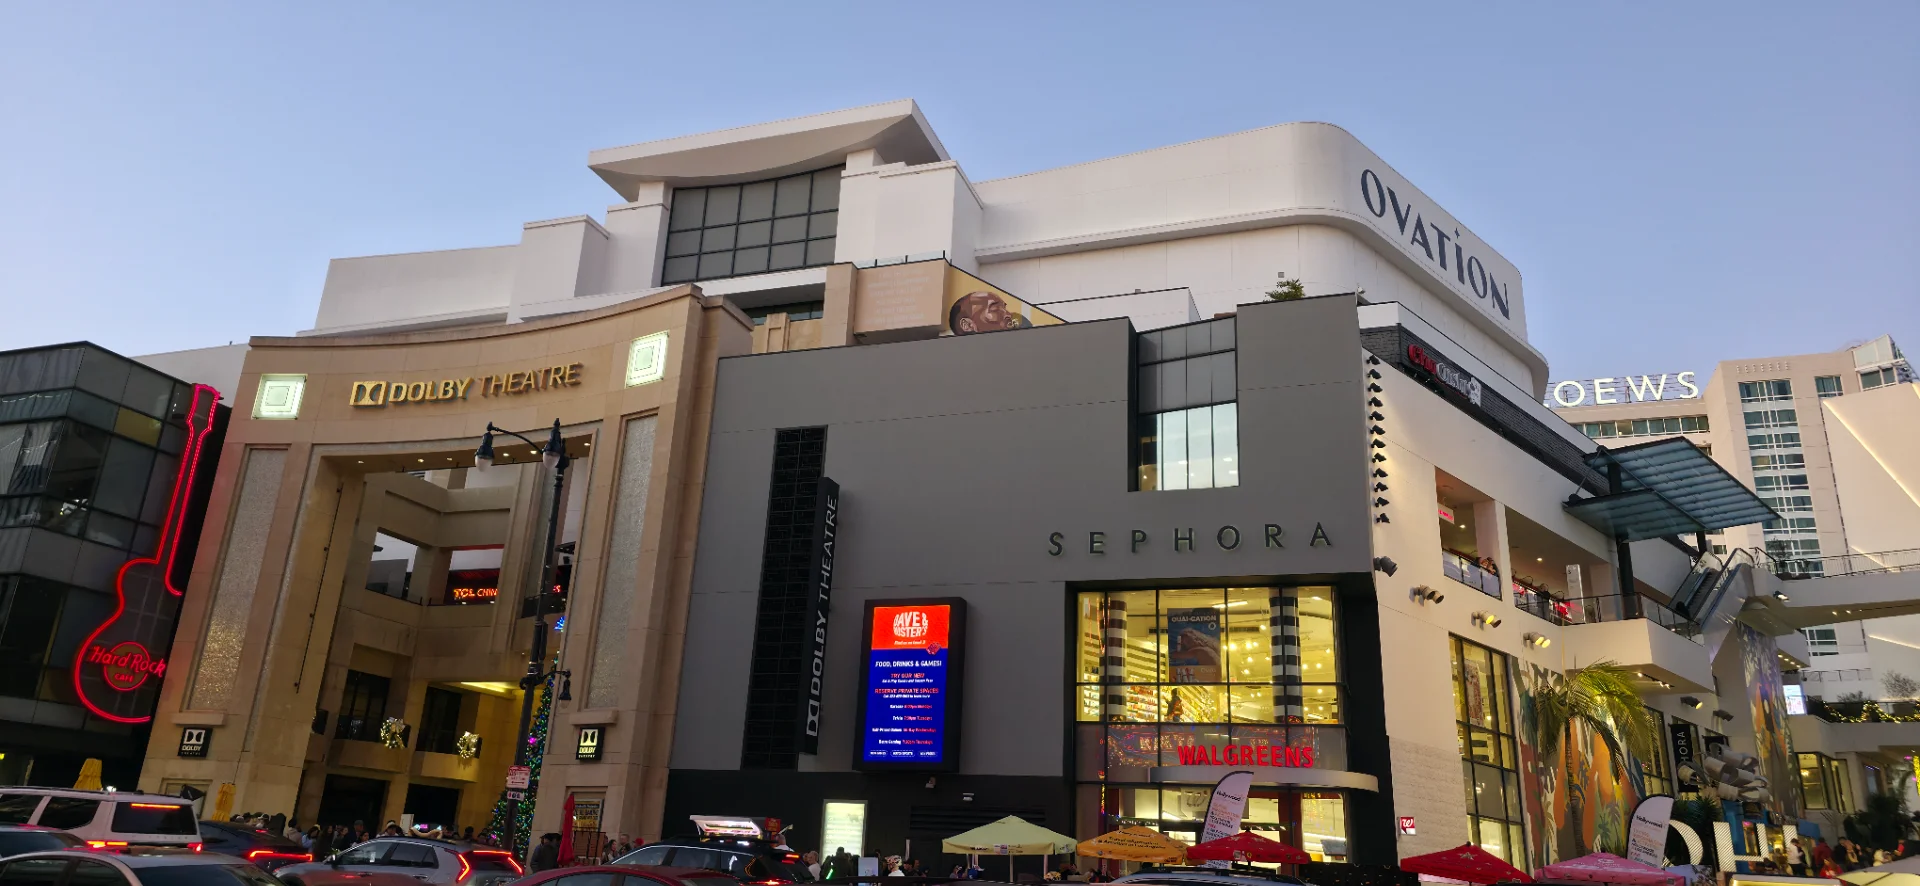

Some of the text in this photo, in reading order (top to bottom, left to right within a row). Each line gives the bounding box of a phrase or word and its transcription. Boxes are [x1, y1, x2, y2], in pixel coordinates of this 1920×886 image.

[389, 361, 583, 405] DOLBY THEATRE
[1543, 371, 1699, 408] OEWS
[1048, 521, 1333, 558] SEPHORA
[477, 588, 499, 598] CHIN
[811, 495, 838, 697] DOLBY THEATRE
[893, 611, 929, 627] DAVE &
[89, 645, 167, 678] Hard Rock
[875, 660, 892, 668] FOOD,
[1178, 744, 1314, 769] WALGREENS
